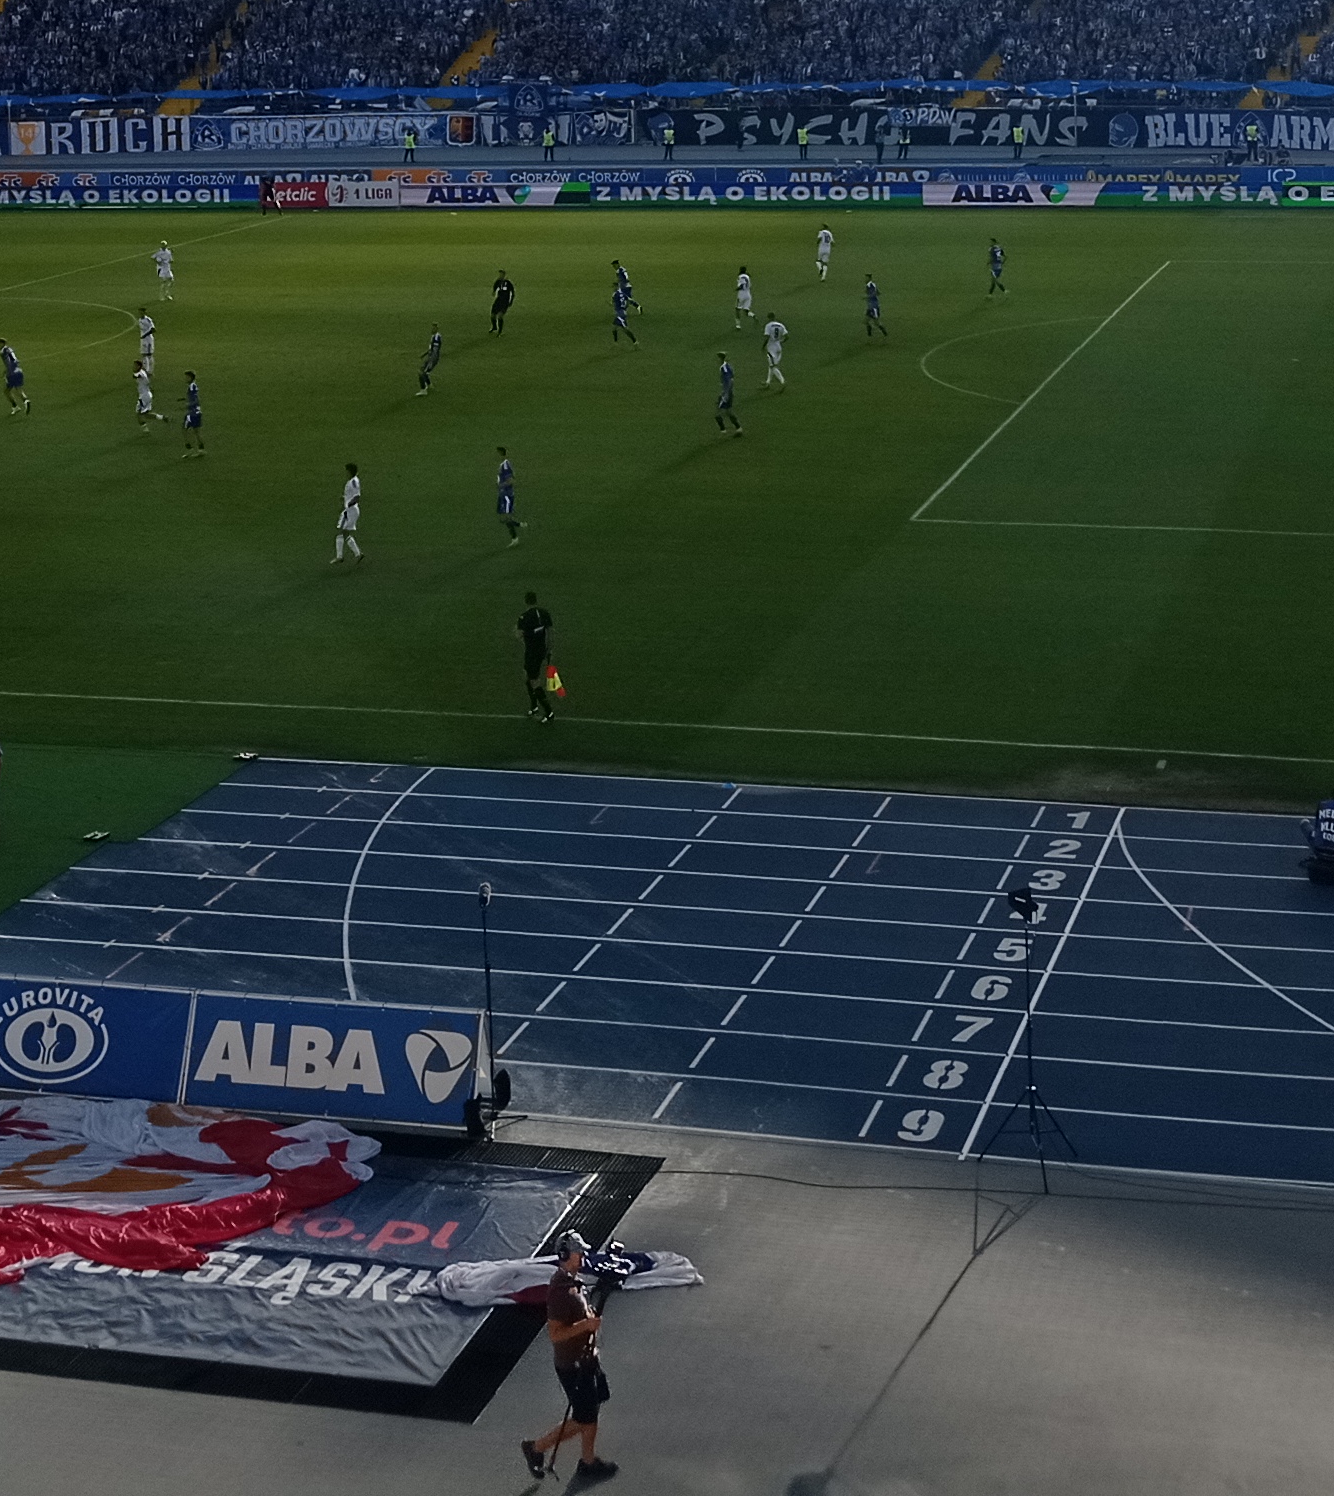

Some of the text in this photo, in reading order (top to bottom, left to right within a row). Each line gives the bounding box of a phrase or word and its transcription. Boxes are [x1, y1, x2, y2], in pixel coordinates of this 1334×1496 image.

[51, 116, 190, 154] RUCH
[949, 112, 1089, 146] FANS
[1145, 112, 1232, 147] BLUE
[113, 173, 170, 186] CHORZÓW
[178, 173, 236, 185] CHORZÓW
[510, 170, 571, 183] CHORZÓW
[578, 169, 640, 183] CHORZÓW
[83, 189, 100, 203] O
[108, 189, 230, 203] EKOLOGII
[365, 189, 392, 199] LIGA
[426, 187, 500, 203] ALBA
[596, 183, 891, 205] Z MYŚLĄ O EKOLOGII
[952, 184, 1033, 202] ALBA
[1142, 186, 1158, 201] Z
[1169, 182, 1278, 205] MYŚLĄ
[1288, 186, 1309, 201] O
[1067, 811, 1091, 829] 1
[1043, 839, 1082, 859] 2
[1028, 870, 1067, 891] 3
[993, 938, 1034, 962] 5
[971, 975, 1013, 1001] 6
[2, 987, 105, 1026] UROVITA
[951, 1015, 994, 1042] 7
[194, 1019, 386, 1095] ALBA
[922, 1060, 969, 1090] 8
[897, 1109, 945, 1142] 9
